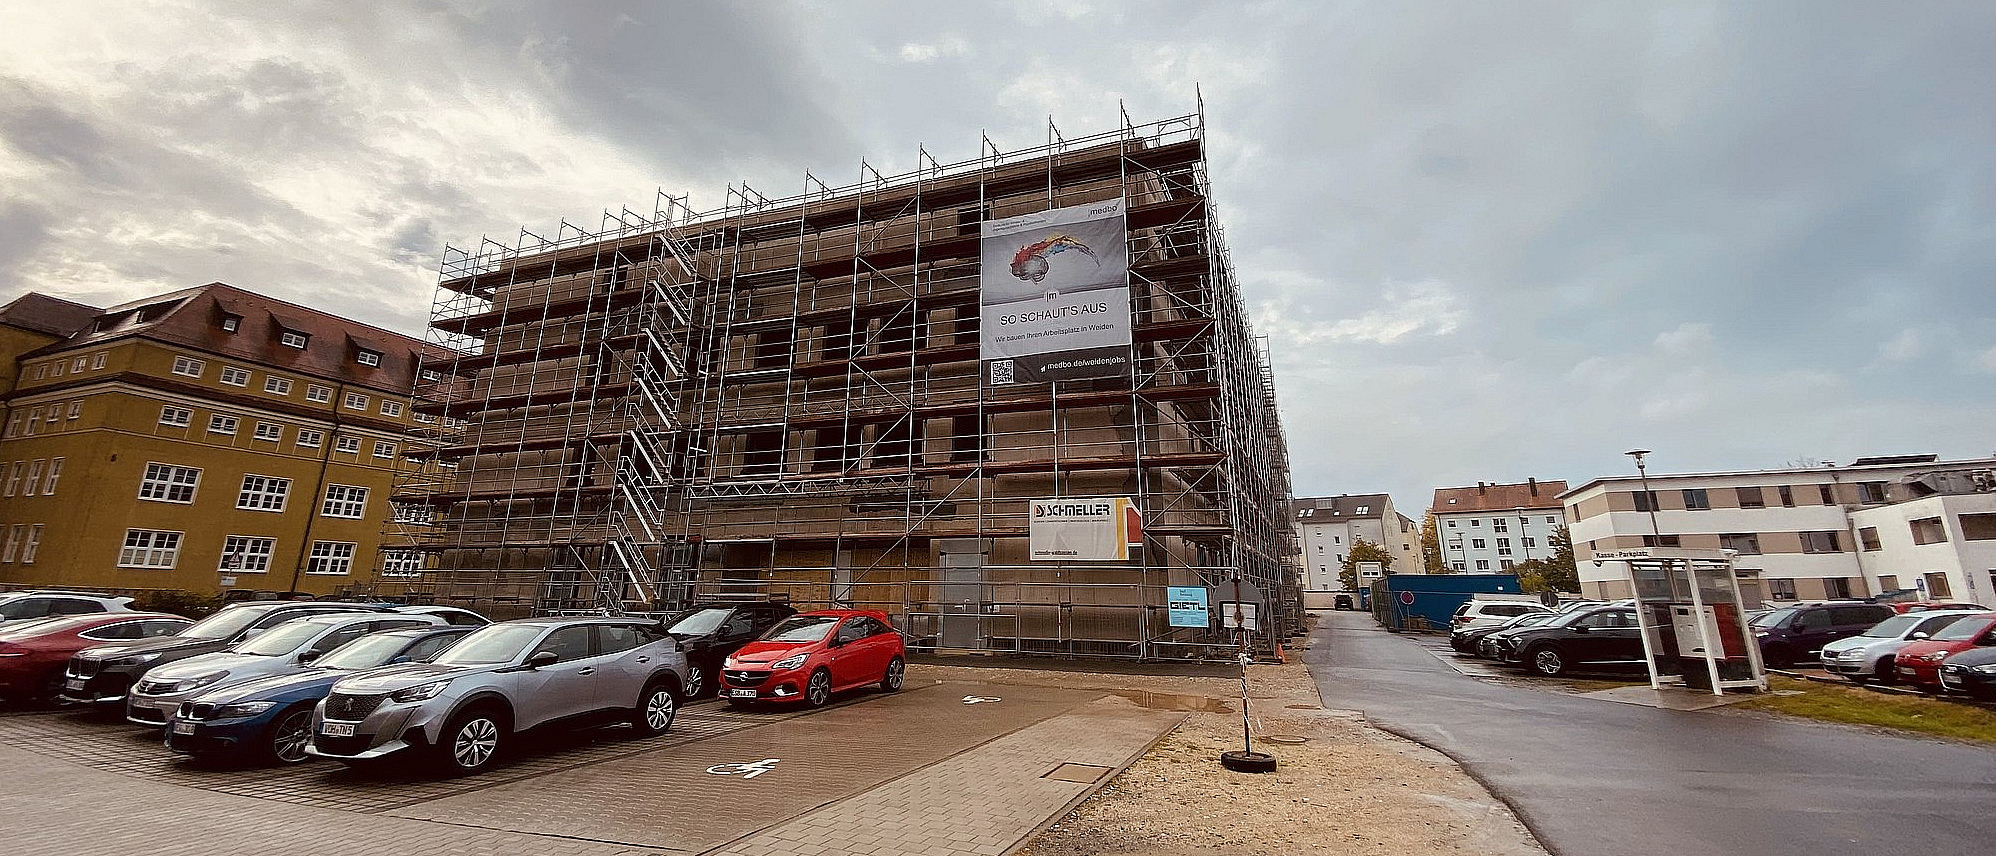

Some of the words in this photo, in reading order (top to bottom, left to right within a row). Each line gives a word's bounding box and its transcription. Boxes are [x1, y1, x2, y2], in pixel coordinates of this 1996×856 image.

[1091, 205, 1117, 215] medbo
[1001, 315, 1016, 325] SO
[1020, 306, 1078, 322] SCHAUT'S
[1081, 303, 1107, 314] AUS
[1043, 327, 1079, 336] Arbeitsplatz
[1047, 504, 1110, 517] SCHMELLER
[1170, 602, 1206, 611] GIETL
